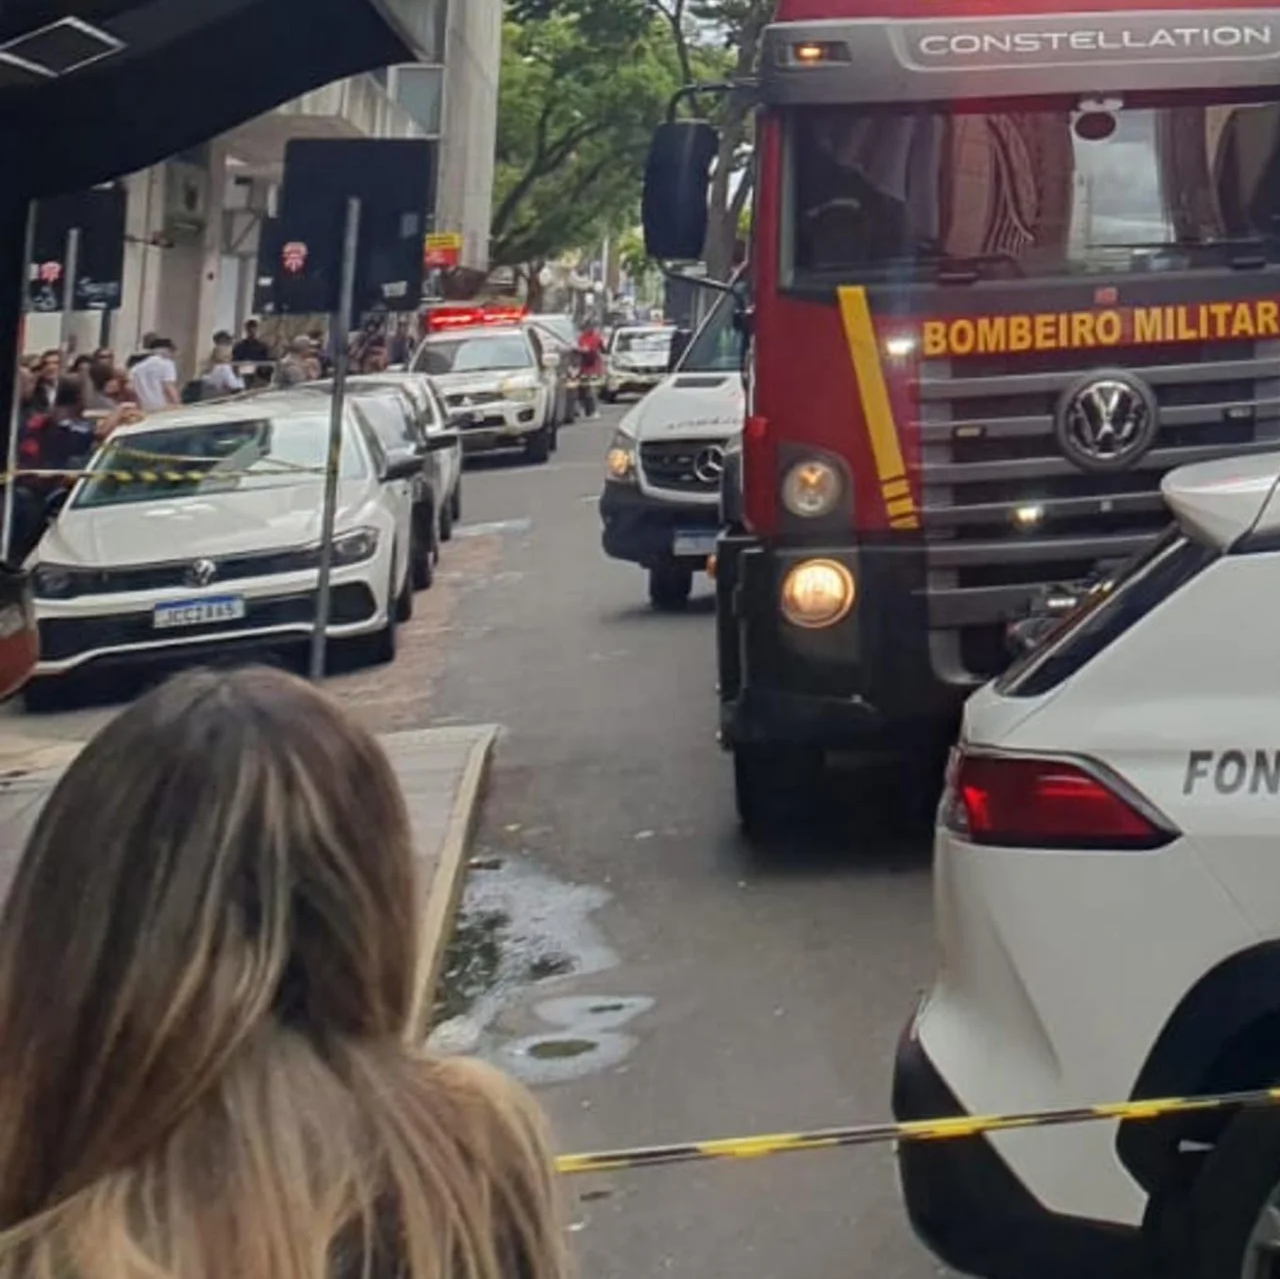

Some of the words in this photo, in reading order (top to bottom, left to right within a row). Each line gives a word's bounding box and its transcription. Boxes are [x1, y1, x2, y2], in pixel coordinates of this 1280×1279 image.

[918, 25, 1272, 56] CONSTELLATION
[922, 310, 1123, 356] BOMBEIRO
[1133, 300, 1279, 343] MILITAR
